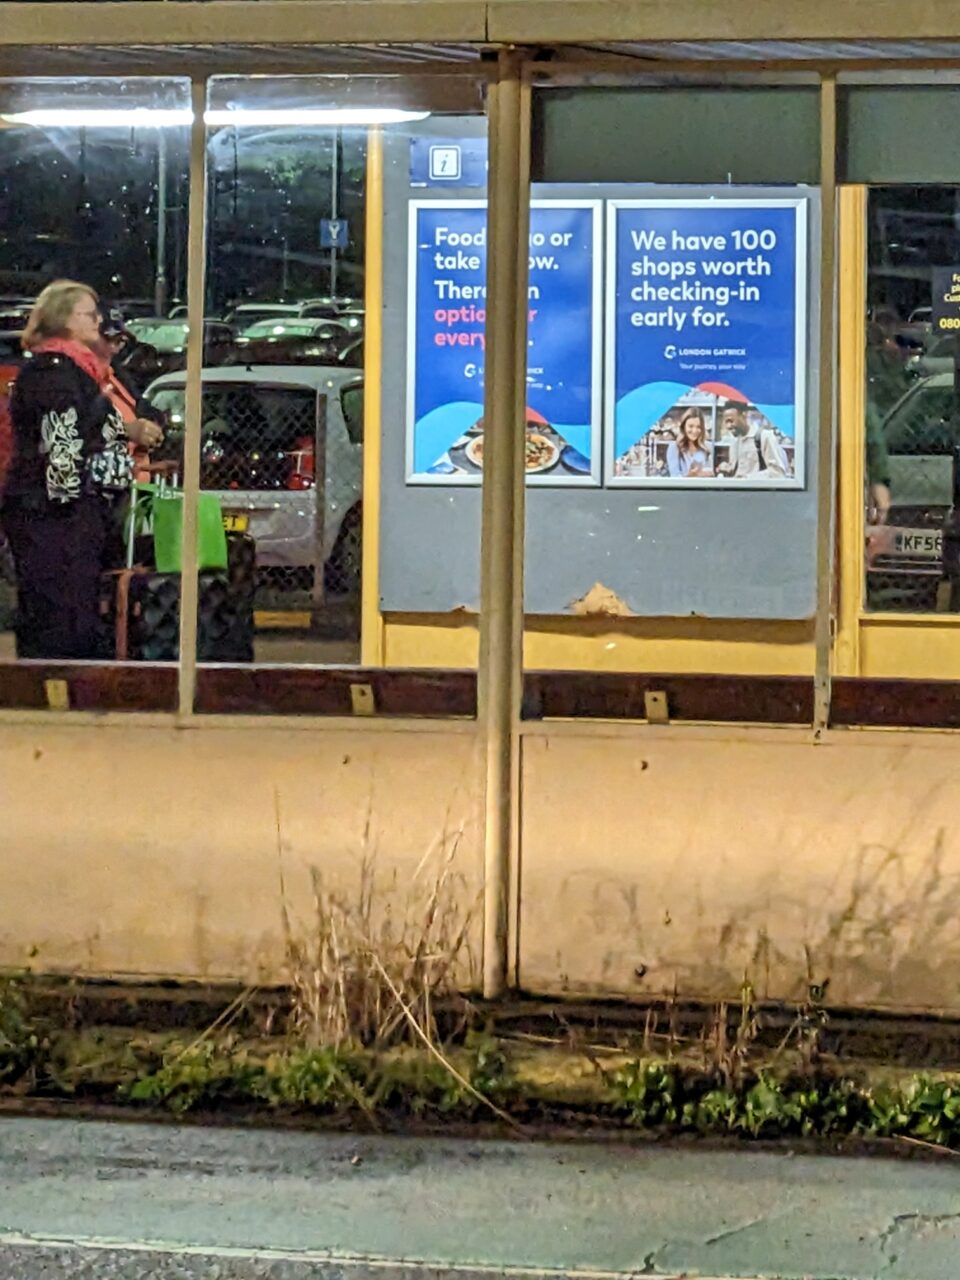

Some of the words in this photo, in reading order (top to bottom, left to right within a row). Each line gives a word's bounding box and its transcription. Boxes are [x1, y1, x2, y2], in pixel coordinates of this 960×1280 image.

[435, 227, 487, 246] Food
[550, 232, 573, 246] or
[631, 230, 667, 250] We
[671, 229, 727, 250] have
[731, 229, 776, 250] 100
[433, 250, 481, 269] take
[631, 255, 697, 281] shops
[701, 255, 771, 276] worth
[433, 279, 487, 300] Ther
[630, 280, 760, 306] checking-in
[434, 304, 487, 327] optio
[630, 306, 687, 331] early
[691, 306, 730, 327] for.
[678, 348, 712, 356] LONDON
[713, 348, 746, 356] GATWICK
